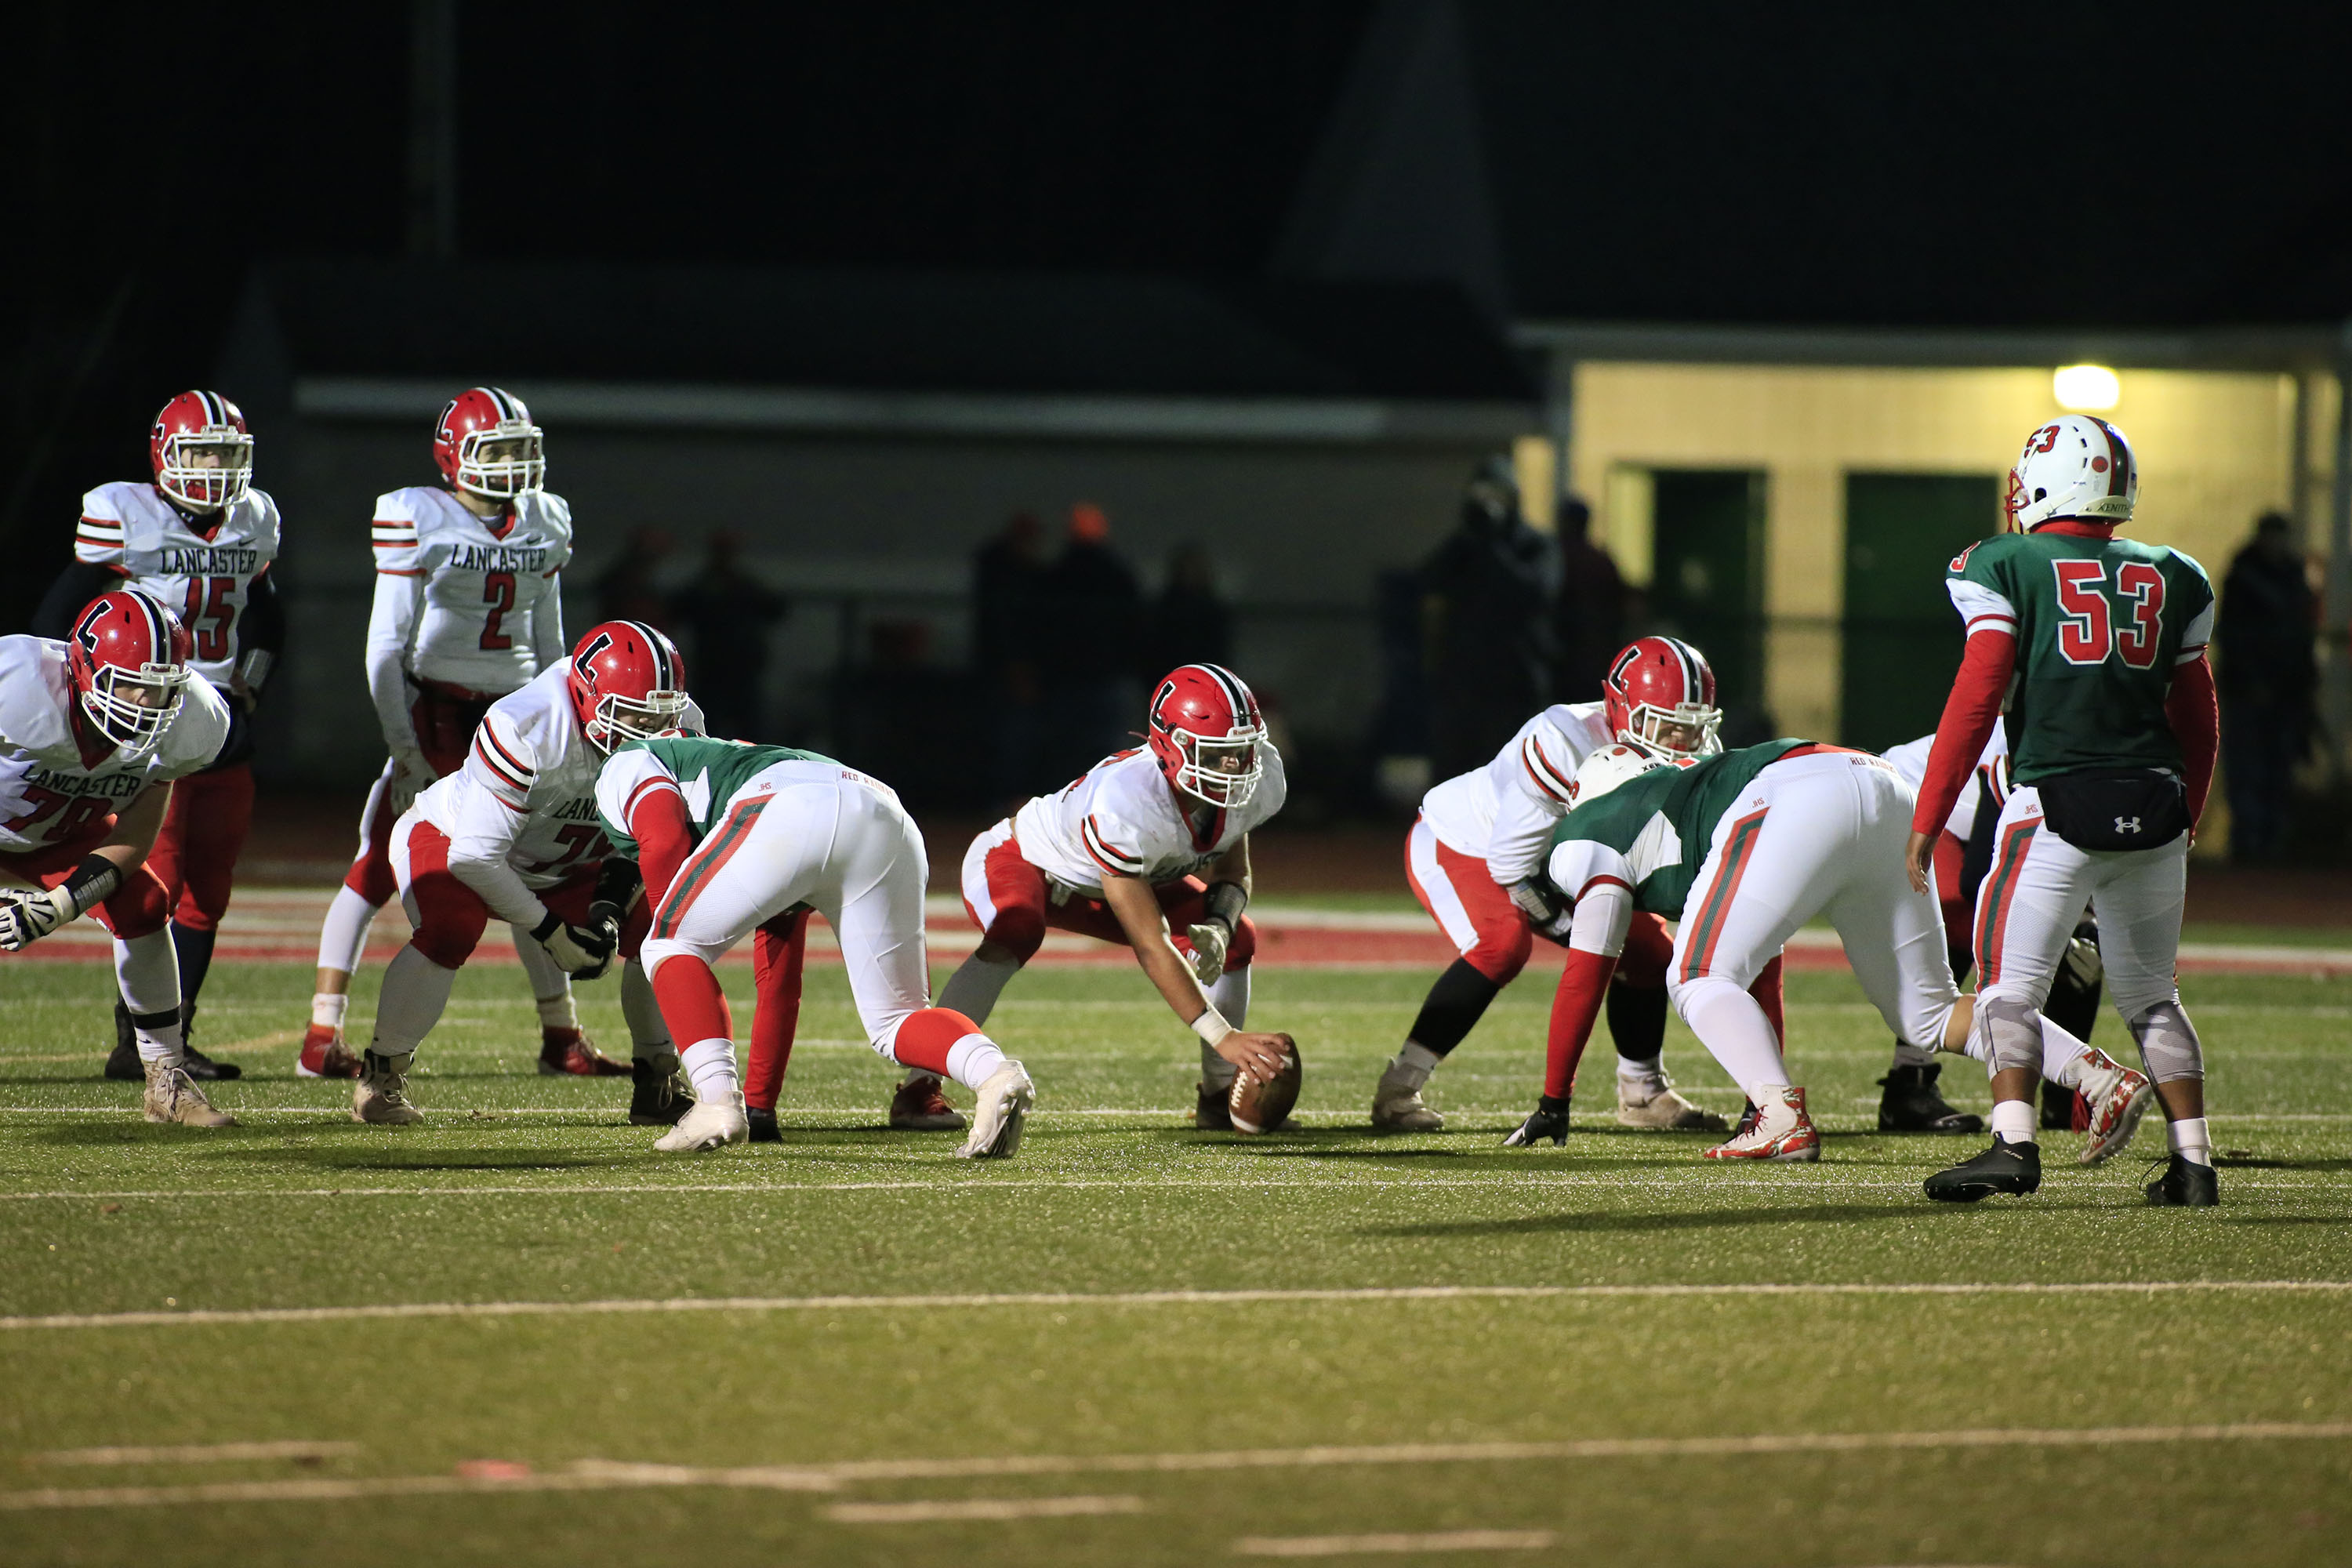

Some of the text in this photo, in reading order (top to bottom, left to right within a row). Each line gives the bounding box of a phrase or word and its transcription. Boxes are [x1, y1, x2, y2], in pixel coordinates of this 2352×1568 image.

[160, 549, 257, 574] LANCASTER
[450, 544, 546, 573] LANCASTER
[75, 599, 114, 653] L
[180, 576, 236, 661] 15
[479, 572, 517, 651] 2
[2051, 559, 2167, 670] 53
[575, 630, 614, 685] L
[1609, 645, 1642, 695] L
[1150, 680, 1176, 733] L
[20, 764, 141, 797] LANCASTER
[841, 771, 859, 782] RED
[1849, 757, 1867, 766] RED
[758, 782, 771, 792] JHS
[1751, 797, 1765, 808] JHS
